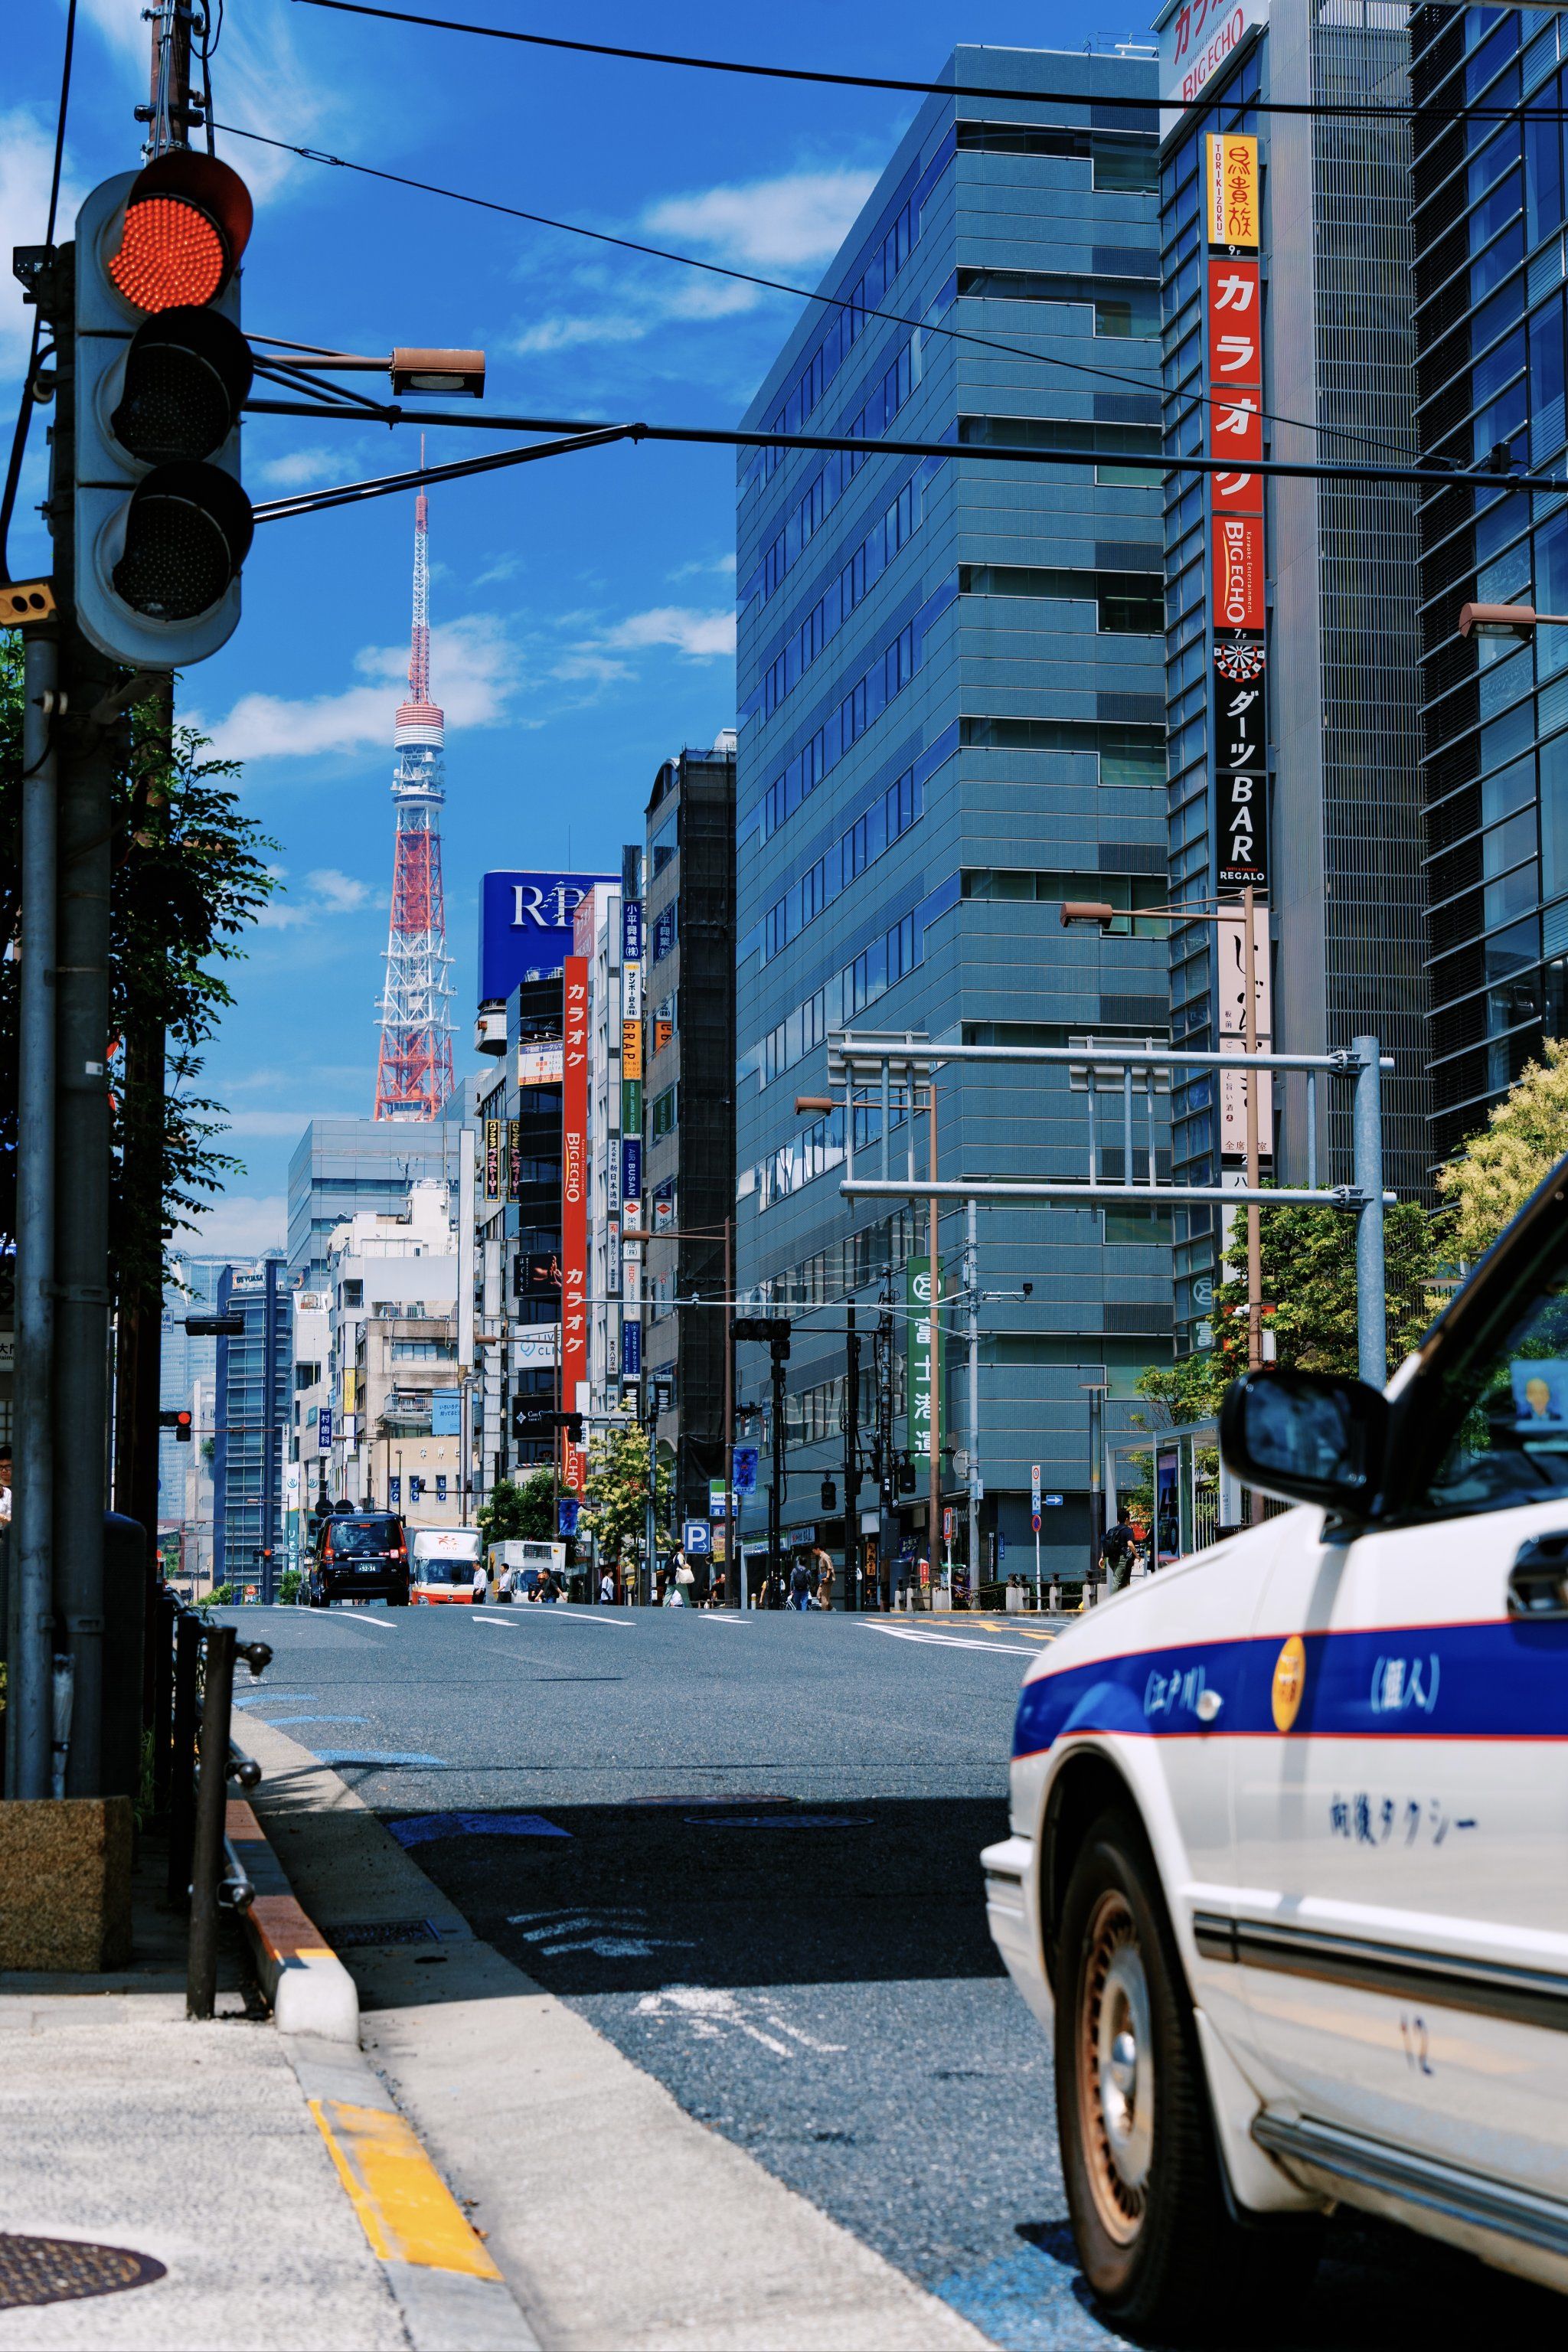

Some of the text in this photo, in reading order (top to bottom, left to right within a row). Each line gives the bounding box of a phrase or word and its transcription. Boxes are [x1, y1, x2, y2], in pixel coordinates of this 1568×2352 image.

[1183, 8, 1244, 114] BIG ECHO
[1228, 145, 1252, 237] 鳥貴族
[1228, 244, 1241, 256] 9F
[1225, 521, 1246, 616] BIG ECHO
[1234, 628, 1247, 639] 7F
[1227, 691, 1259, 768] ダーツ
[1229, 776, 1253, 862] BAR
[1220, 871, 1265, 880] REGALO
[625, 904, 639, 957] 小平興業(株)
[567, 984, 585, 1067] カラオケ
[567, 1133, 580, 1203] BIG ECHO
[628, 1148, 636, 1195] AIR BUSAN
[1225, 1140, 1267, 1152] 全席室
[565, 1269, 584, 1354] カラオケ
[690, 1526, 707, 1550] P
[1370, 1654, 1440, 1713] (個人)
